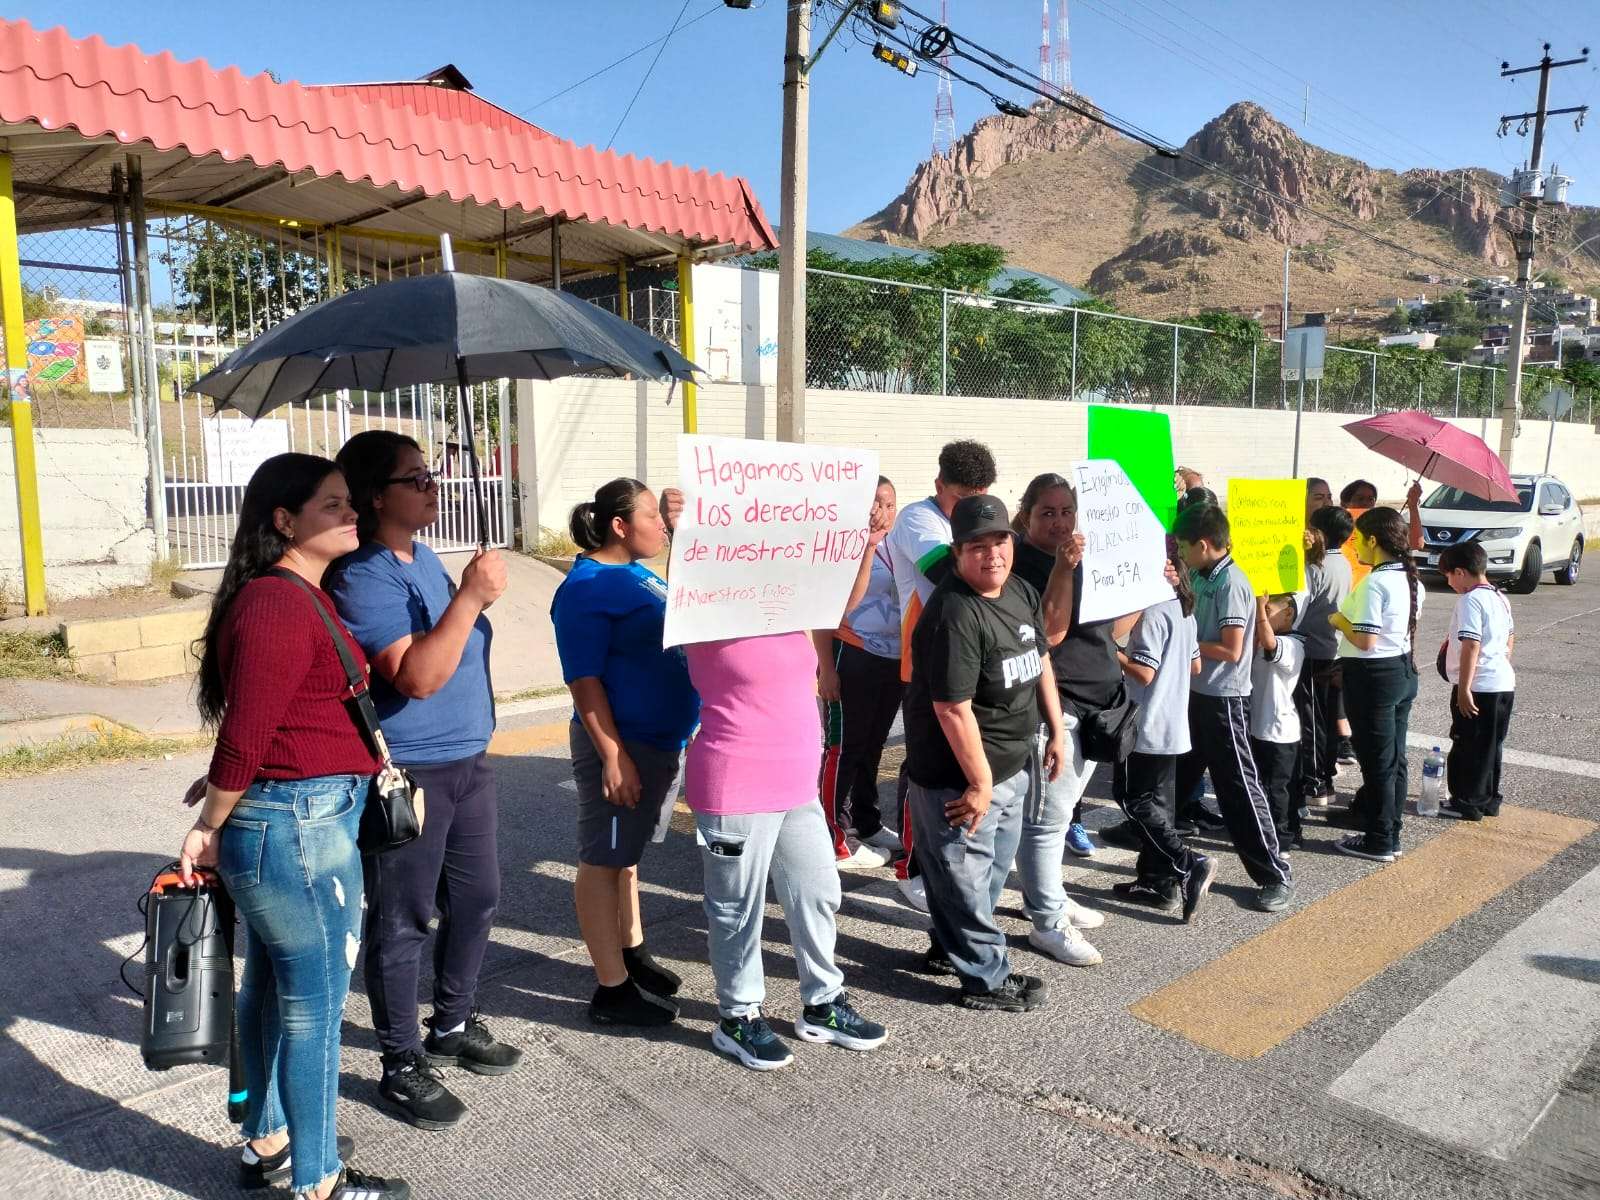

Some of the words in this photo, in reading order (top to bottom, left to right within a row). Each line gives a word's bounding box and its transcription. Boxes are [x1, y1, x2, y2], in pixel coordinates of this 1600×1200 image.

[694, 445, 804, 496] Hagamos
[811, 459, 864, 483] valer
[744, 496, 839, 524] derechos
[1125, 501, 1144, 516] con
[683, 538, 709, 562] de
[716, 538, 806, 563] nuestros
